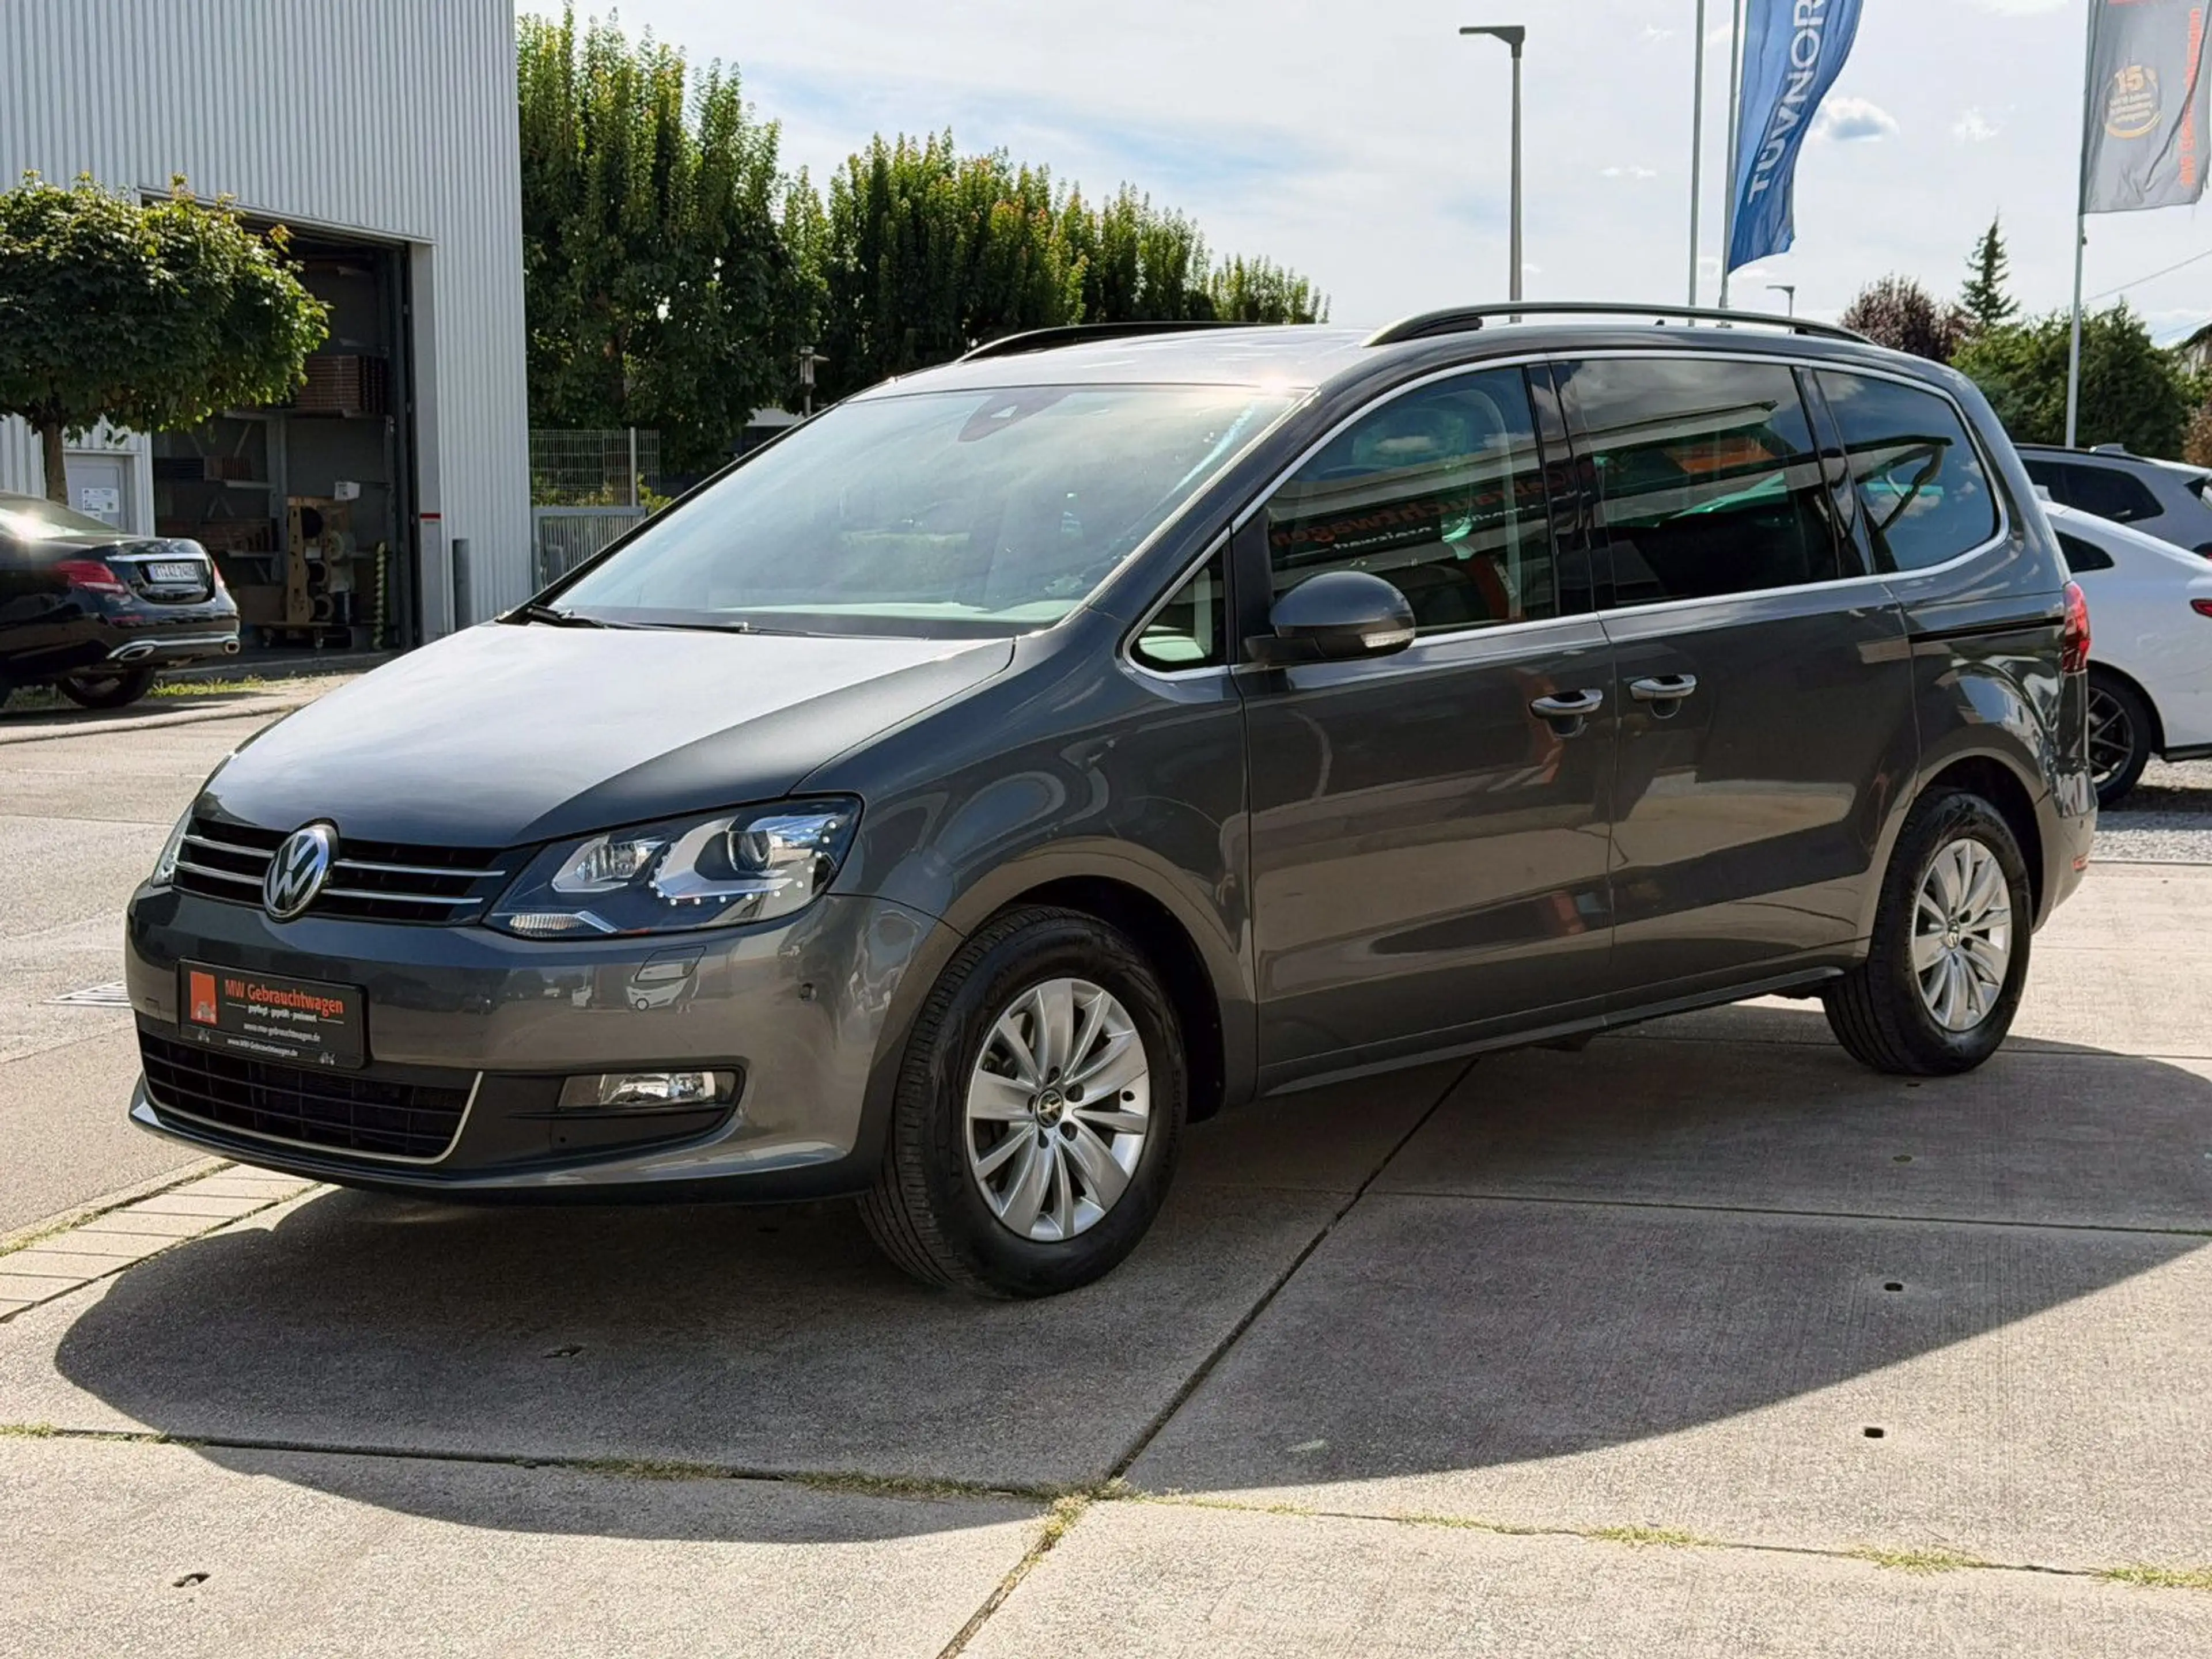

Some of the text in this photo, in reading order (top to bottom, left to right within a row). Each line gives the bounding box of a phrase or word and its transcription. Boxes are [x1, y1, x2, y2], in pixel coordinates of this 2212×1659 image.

[2114, 65, 2144, 94] 15
[225, 979, 344, 1017] MW Gebrauchtwagen
